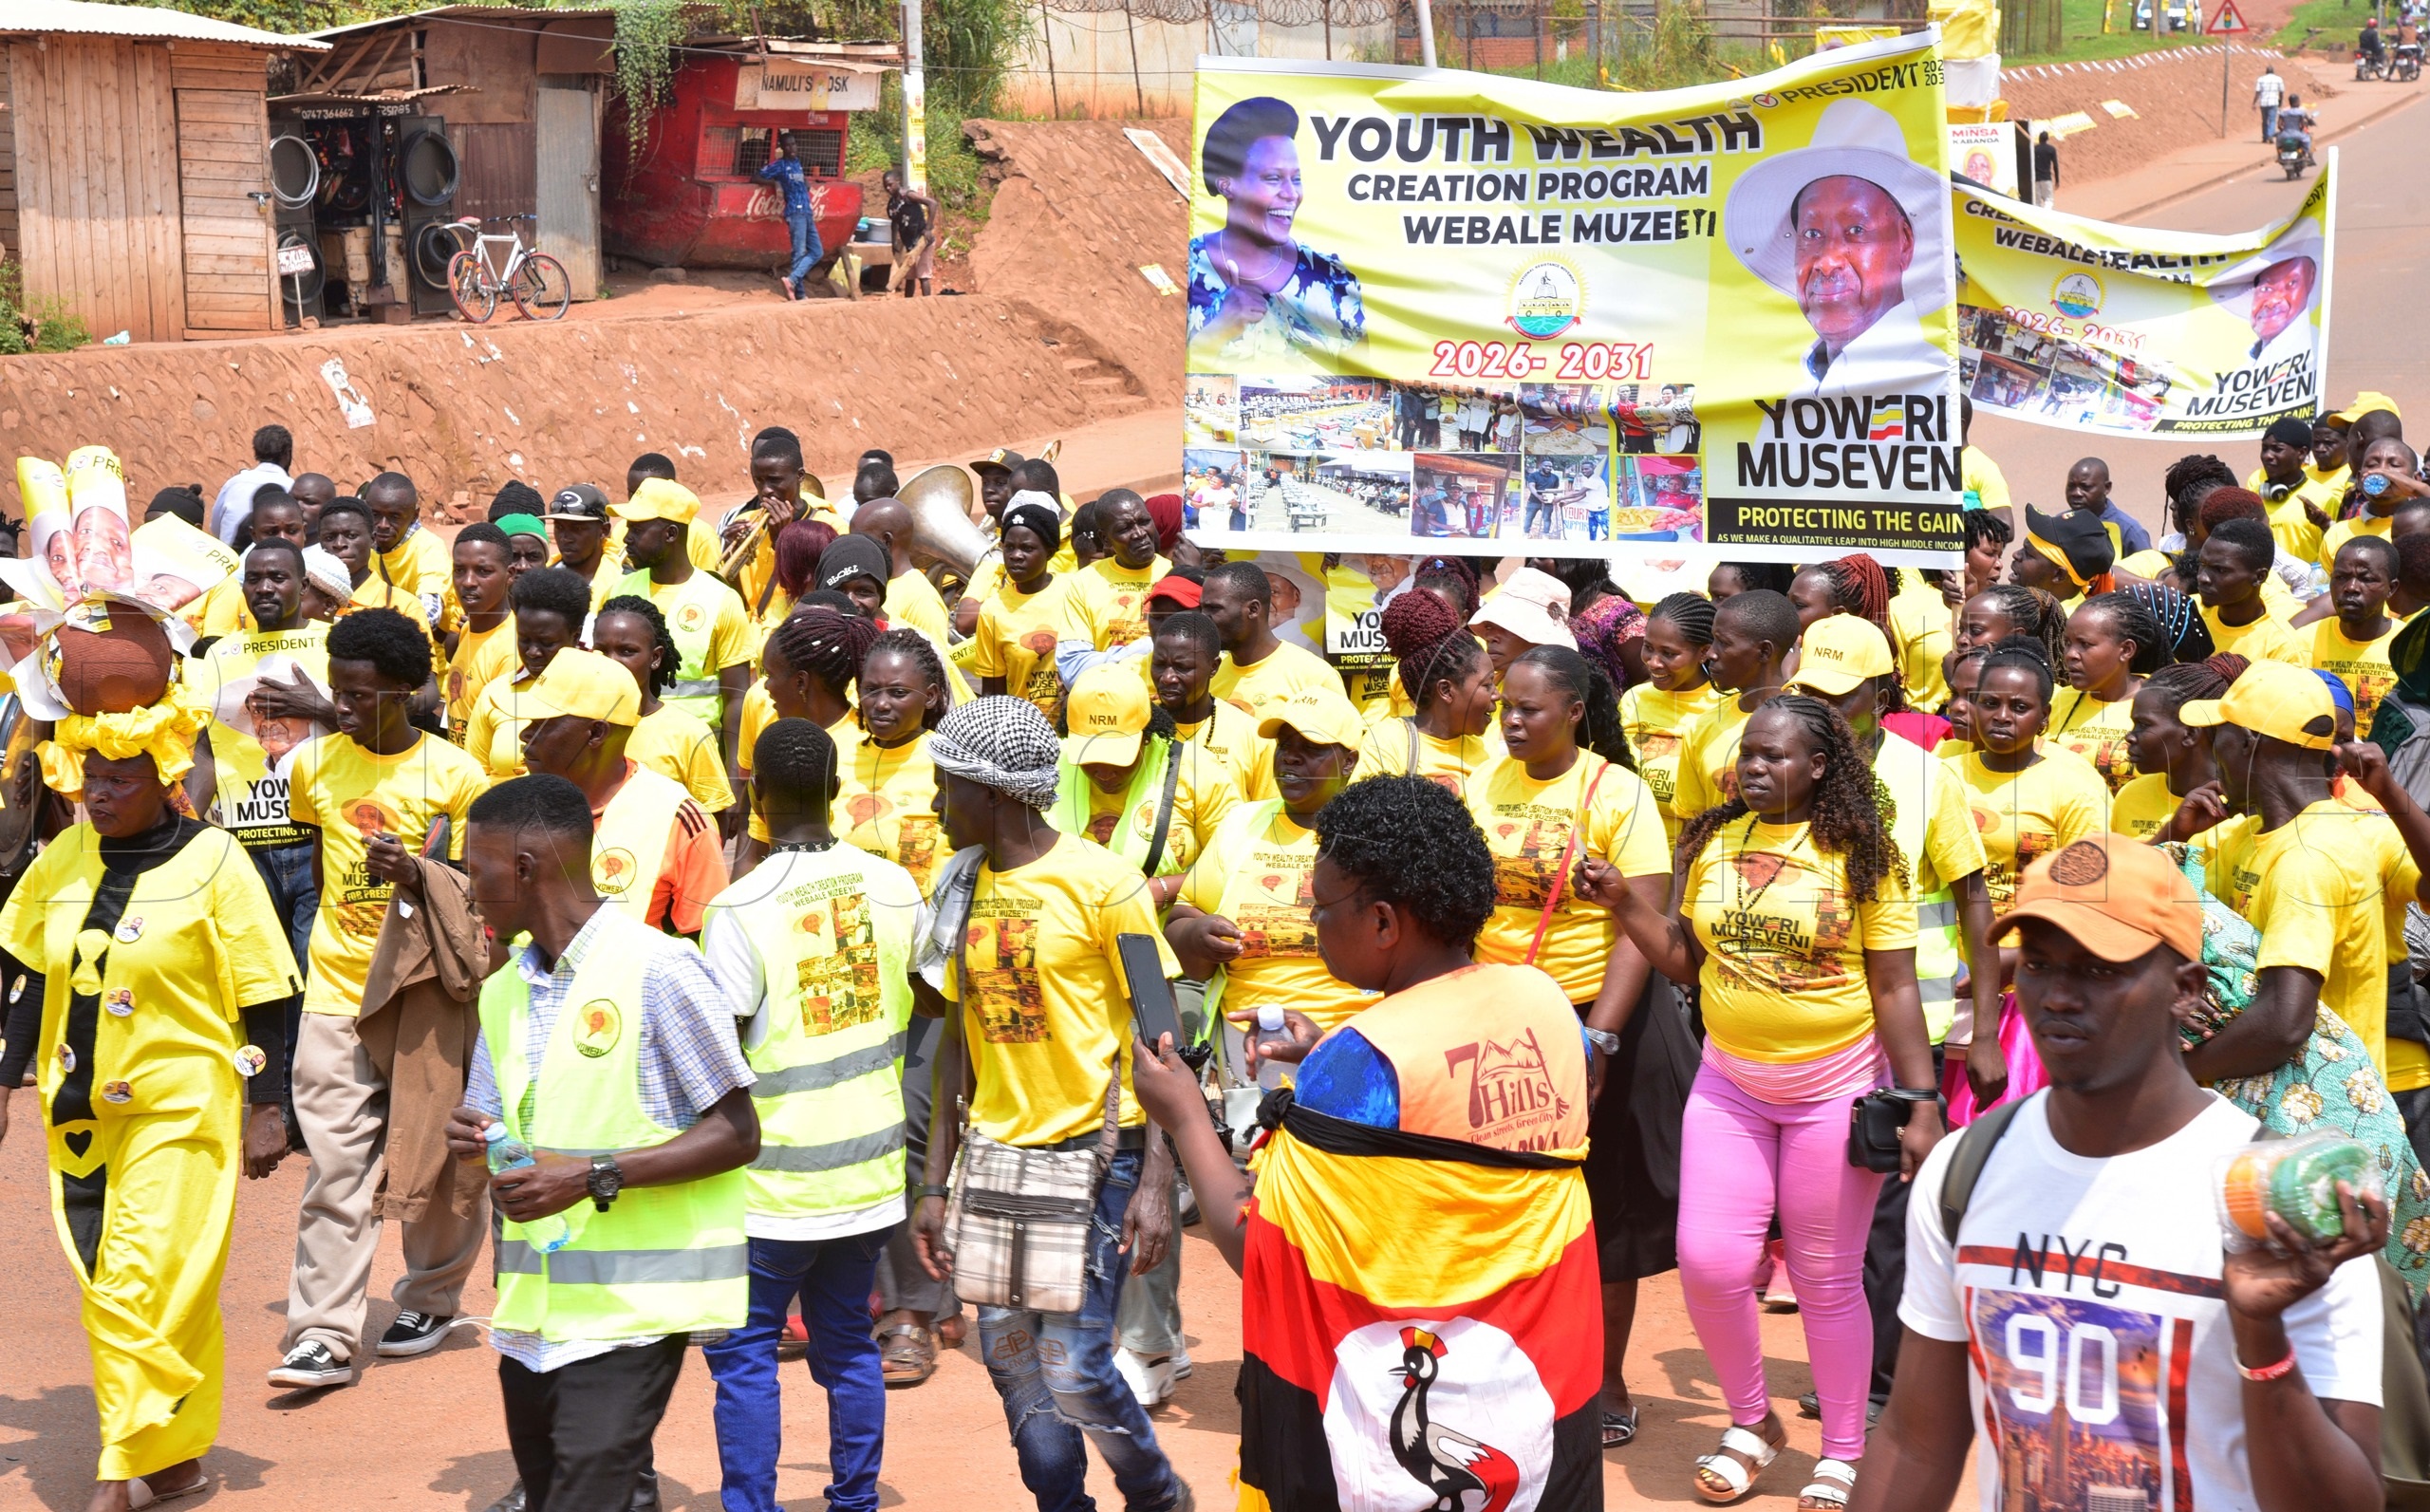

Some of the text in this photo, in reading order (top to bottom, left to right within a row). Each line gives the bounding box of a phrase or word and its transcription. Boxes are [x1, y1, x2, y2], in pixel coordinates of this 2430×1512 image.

[761, 74, 813, 92] NAMULI'S
[1781, 63, 1918, 103] PRESIDENT
[1310, 111, 1761, 163] YOUTH WEALTH
[1951, 128, 1999, 138] MINSA
[1348, 165, 1708, 202] CREATION PROGRAM
[1403, 214, 1561, 245] WEBALE
[1429, 340, 1654, 380] 2026- 2031
[2215, 349, 2311, 395] YOWERI
[2186, 368, 2317, 416] MUSEVENI
[1754, 394, 1947, 442] YOWERI
[2173, 419, 2254, 431] PROTECTING
[1738, 506, 1866, 530] PROTECTING
[1872, 510, 1913, 532] THE
[1717, 533, 1729, 543] AS
[1730, 533, 1745, 544] WE
[1746, 534, 1771, 544] MAKE
[1772, 534, 1779, 544] A
[1780, 535, 1834, 546] QUALITATIVE
[1835, 536, 1857, 547] LEAP
[1858, 537, 1879, 548] INTO
[1879, 538, 1900, 549] HIGH
[1901, 539, 1934, 550] MIDDLE
[243, 637, 316, 654] PRESIDENT
[1340, 653, 1397, 663] PROTECTING
[1813, 647, 1844, 662] NRM
[2353, 661, 2376, 670] CREATION
[1089, 714, 1117, 726] NRM
[237, 826, 297, 840] PROTECTING
[346, 889, 364, 902] FOR
[1015, 898, 1044, 911] PROGRAM
[1723, 909, 1800, 934] YOWERI
[1710, 922, 1810, 949] MUSEVENI
[1444, 1041, 1551, 1129] 7 Hills
[1470, 1131, 1492, 1144] Clean
[1516, 1117, 1538, 1129] Green
[1539, 1112, 1554, 1124] City
[2010, 1232, 2127, 1299] NYC
[2005, 1312, 2120, 1425] 90
